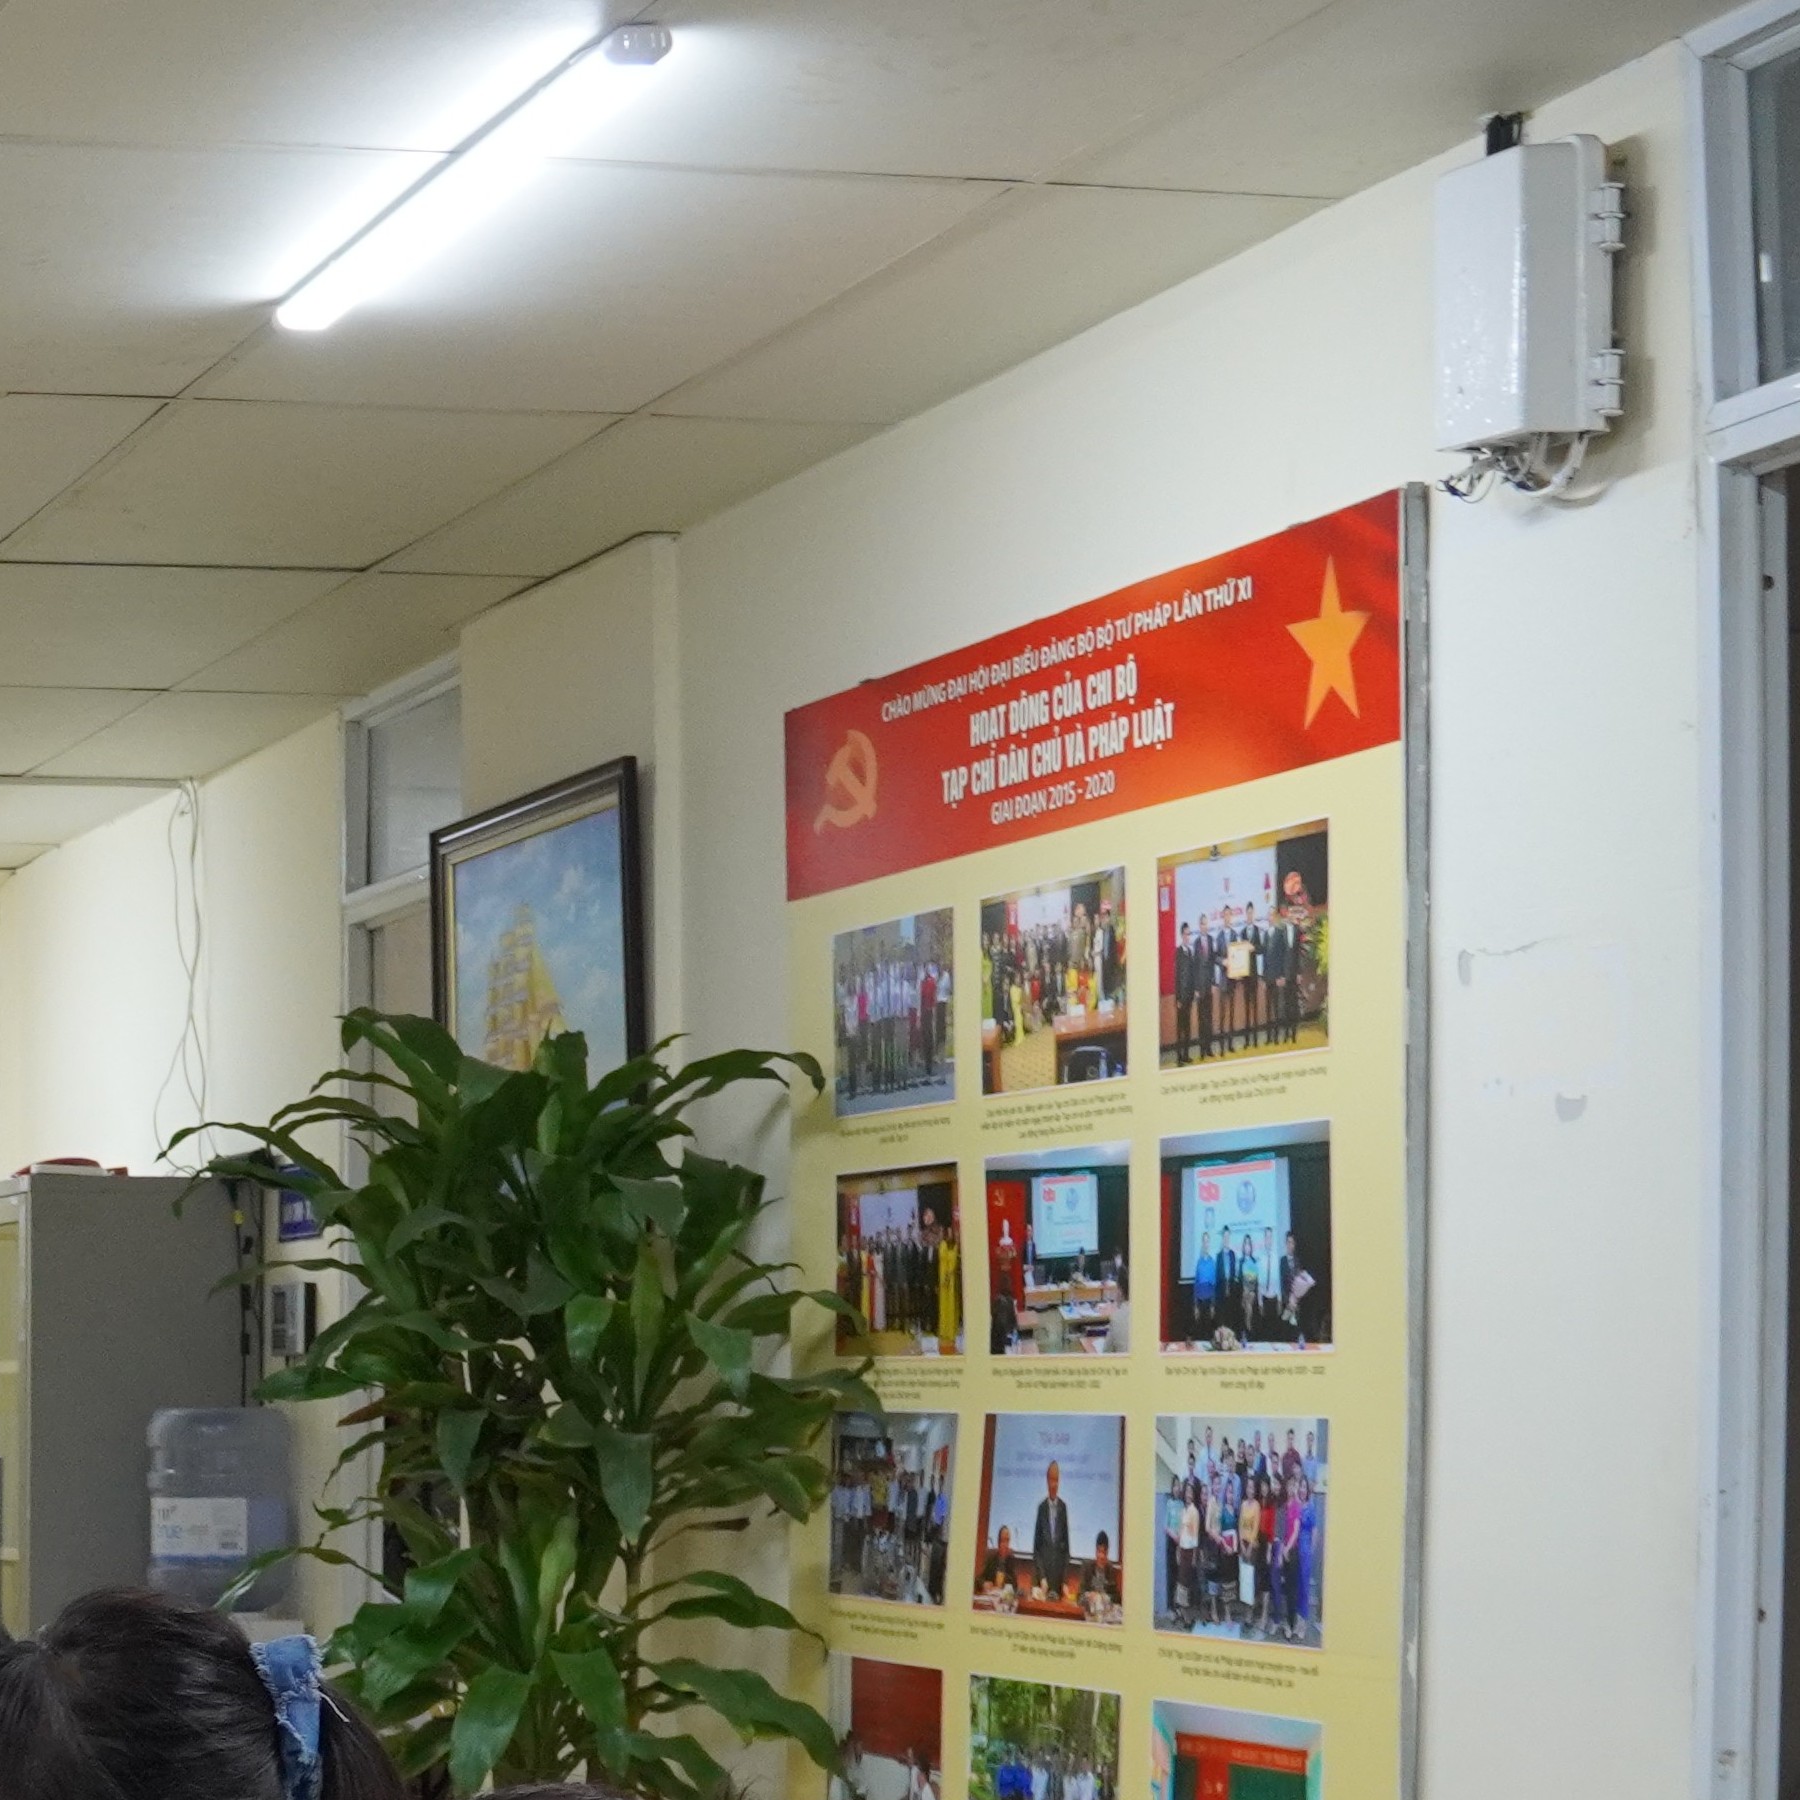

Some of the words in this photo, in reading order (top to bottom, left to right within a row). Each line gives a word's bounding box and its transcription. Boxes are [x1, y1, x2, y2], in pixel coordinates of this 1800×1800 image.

[881, 694, 911, 722] CHÀO
[1077, 626, 1095, 657] BỘ
[1096, 620, 1114, 650] BỘ
[1114, 612, 1133, 641] TƯ
[1134, 602, 1172, 635] PHÁP
[1238, 576, 1253, 603] XI
[969, 704, 1006, 748] HOẠT
[1009, 690, 1049, 738] ĐỘNG
[1052, 670, 1084, 720] CỦA
[1086, 668, 1112, 710] CHI
[1116, 653, 1137, 705] BỘ
[942, 767, 968, 809] TẠP
[998, 743, 1029, 787] DÂN
[1032, 725, 1062, 777] CHỦ
[1064, 723, 1086, 768] VÀ
[1088, 711, 1129, 761] PHÁP
[1132, 698, 1174, 750] LUẬT
[991, 795, 1014, 825] GIAI
[1016, 788, 1048, 818] ĐOẠN
[1049, 780, 1076, 810] 2015
[1084, 769, 1116, 800] 2020
